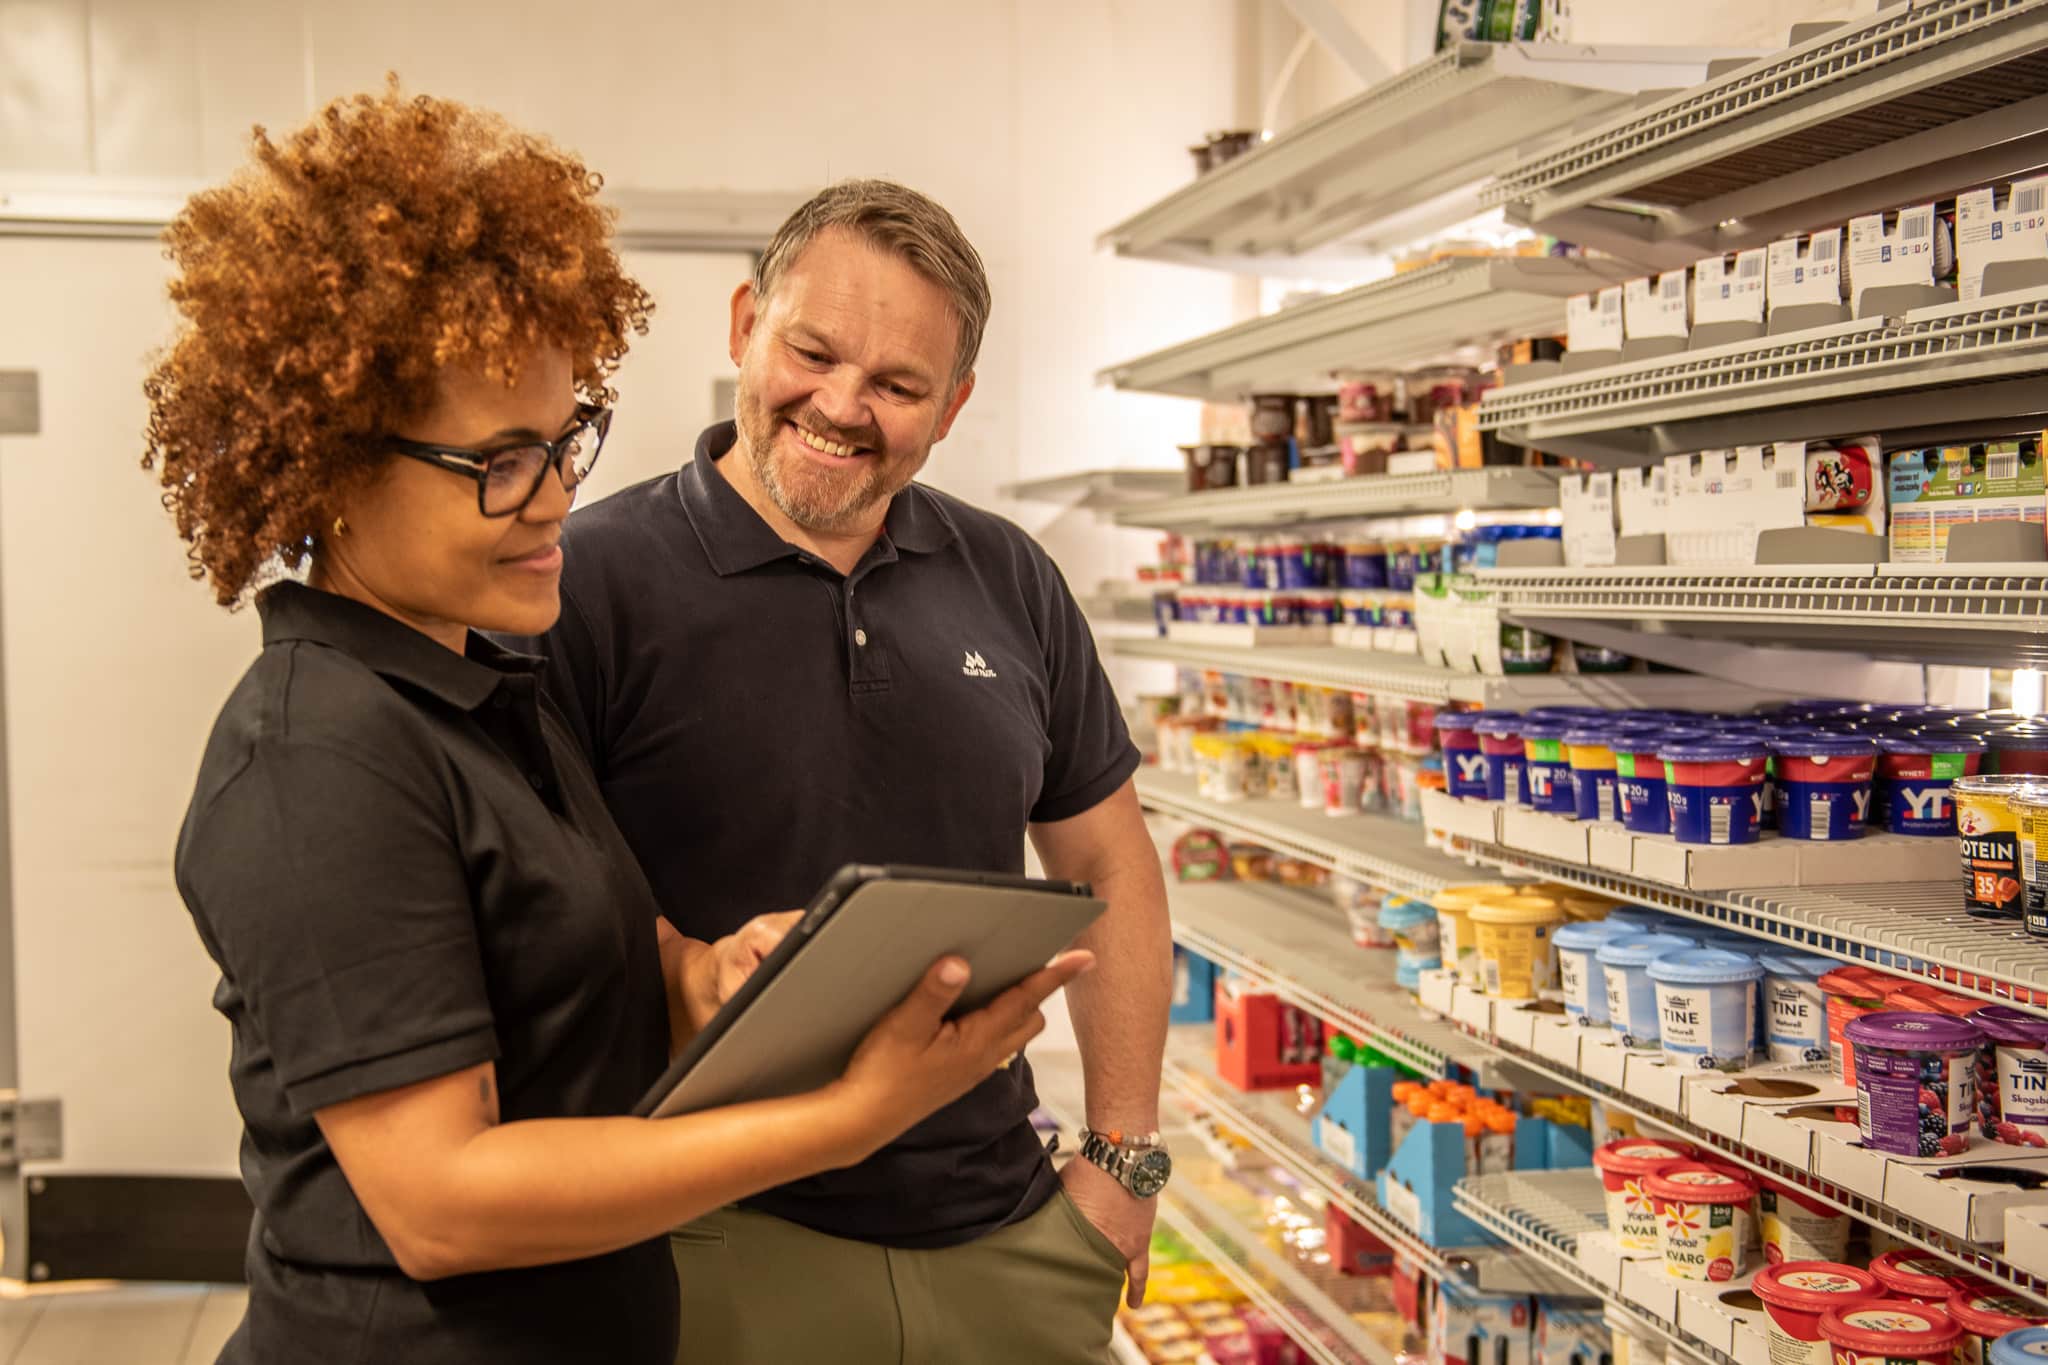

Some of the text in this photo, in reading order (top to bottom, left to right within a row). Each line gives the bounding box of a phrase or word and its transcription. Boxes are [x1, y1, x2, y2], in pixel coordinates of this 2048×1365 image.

[1901, 787, 1950, 819] YT
[1960, 839, 2015, 860] OTEIN
[1977, 875, 1994, 895] 35
[1663, 1008, 1700, 1025] TINE
[1771, 1000, 1809, 1017] TINE
[1622, 1223, 1658, 1237] KVAR
[1666, 1250, 1705, 1265] KVARG
